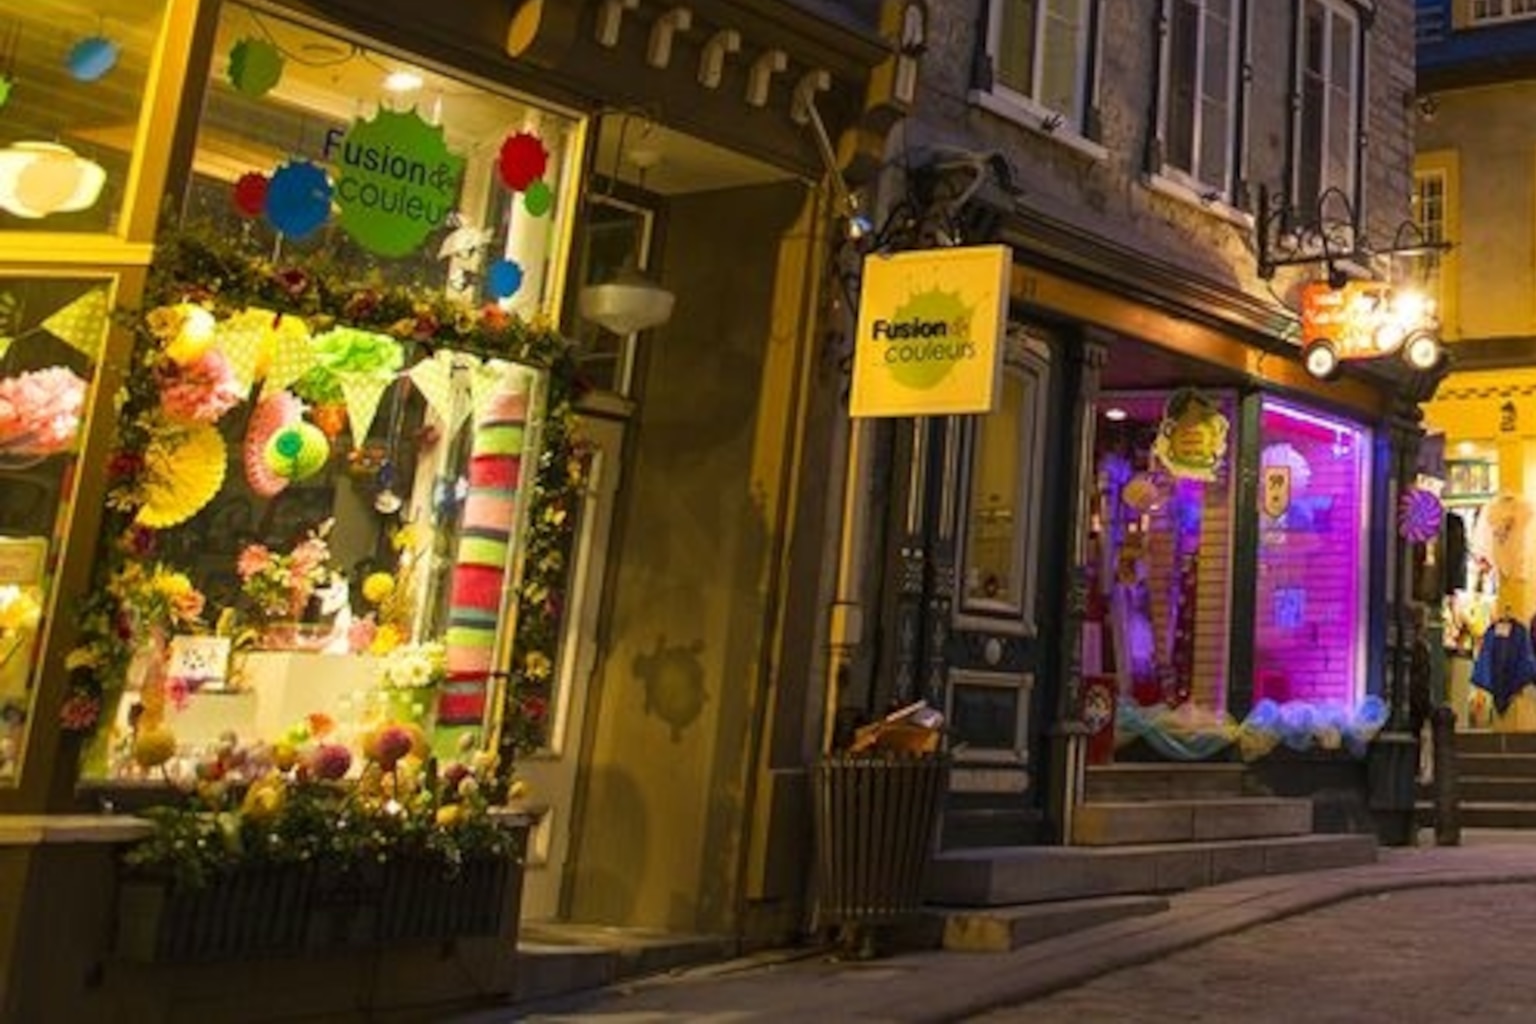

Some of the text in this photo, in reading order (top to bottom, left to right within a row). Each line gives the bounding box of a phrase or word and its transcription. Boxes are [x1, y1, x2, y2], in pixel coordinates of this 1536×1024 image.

[323, 128, 452, 194] Fusion &
[871, 317, 947, 340] Fusion
[884, 341, 976, 363] couleurs
